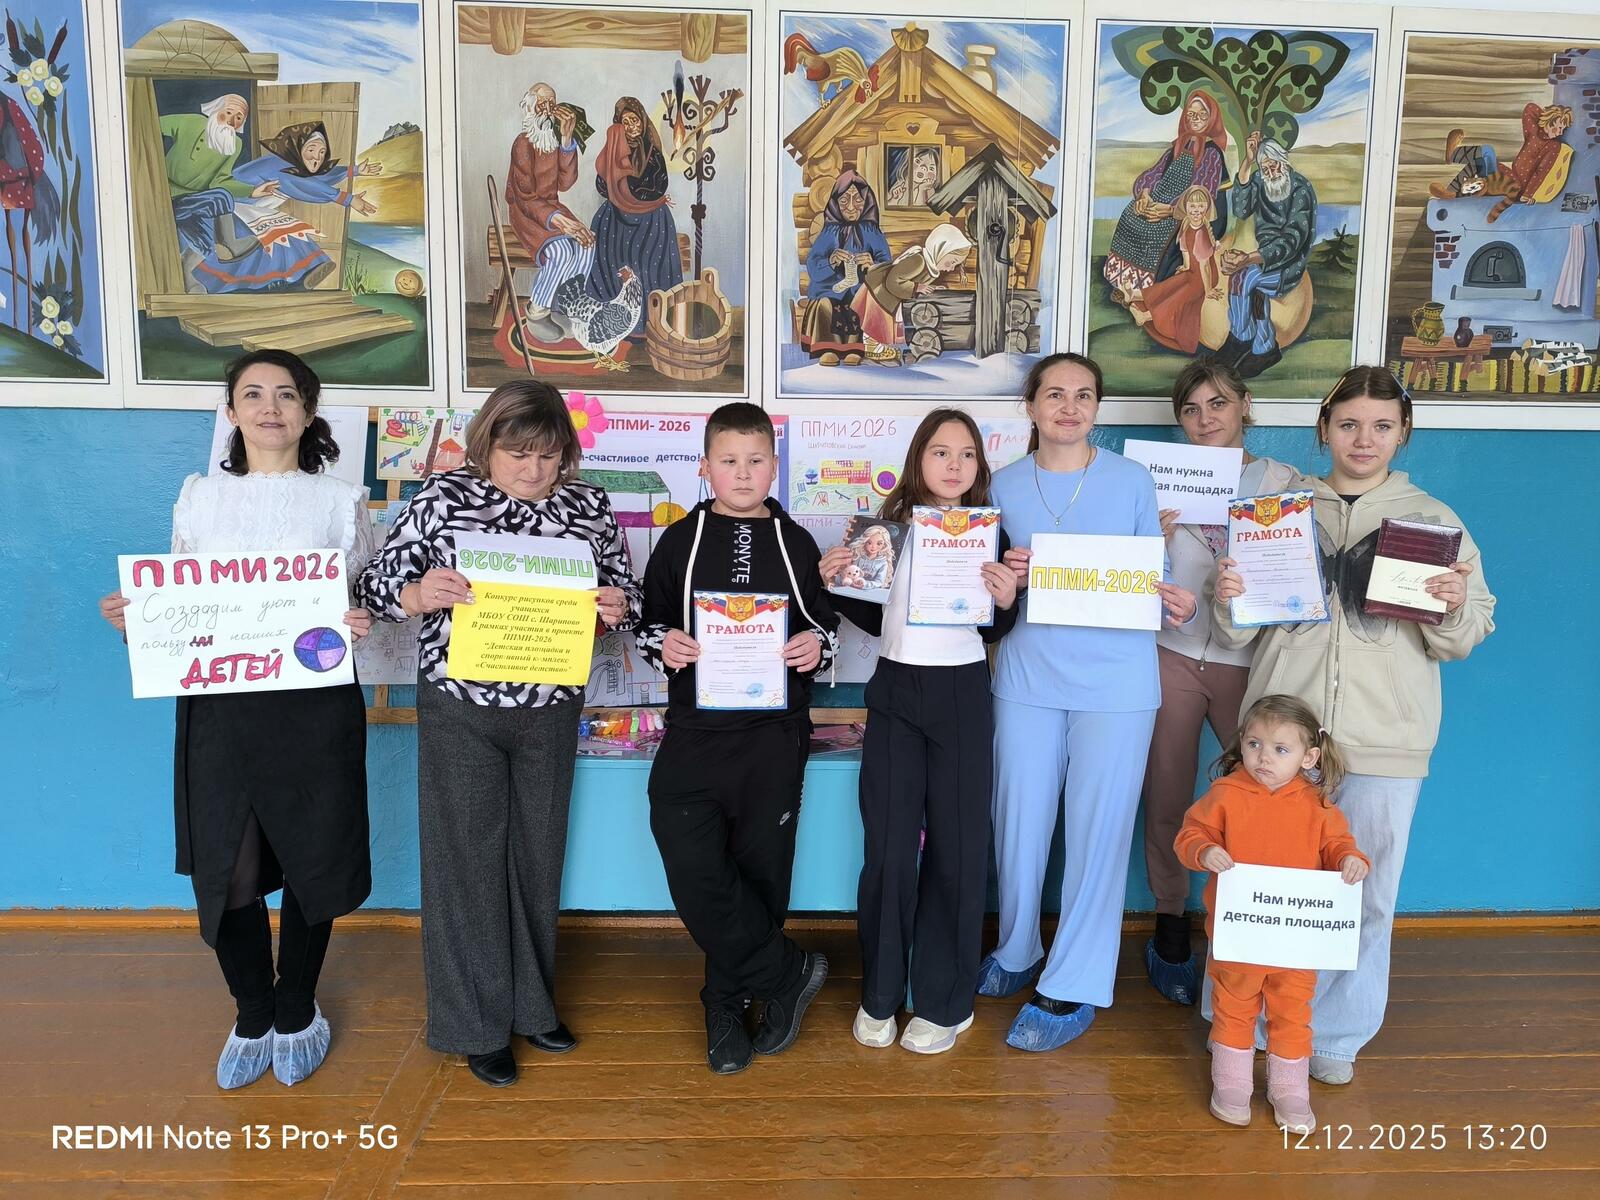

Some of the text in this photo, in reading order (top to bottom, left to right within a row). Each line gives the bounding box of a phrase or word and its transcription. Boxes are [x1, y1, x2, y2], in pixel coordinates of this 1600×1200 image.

[658, 420, 690, 432] 2026
[802, 420, 847, 438] ППМИ
[850, 418, 897, 438] 2026
[656, 453, 701, 462] детство!
[1149, 463, 1214, 479] Нам нужна
[1172, 484, 1234, 496] площадка
[922, 538, 986, 548] ГРАМОТА
[1236, 528, 1303, 542] ГРАМОТА
[133, 552, 339, 588] ППМИ 2026
[460, 549, 594, 578] ППМИ-2026
[1031, 566, 1160, 594] ППМИ-2026
[484, 592, 578, 609] Конкурс рисунков среди
[142, 592, 320, 634] Создадим уют и
[510, 606, 550, 614] учащихся
[478, 612, 506, 620] МБОУ
[506, 614, 530, 622] СОШ
[539, 616, 580, 626] Шарипово
[478, 623, 508, 632] рамках
[510, 625, 544, 633] участия
[552, 628, 584, 636] проекте
[706, 624, 776, 634] ГРАМОТА
[141, 638, 186, 656] пользу
[230, 628, 288, 640] наших
[502, 634, 553, 642] ППМИ-2026
[180, 648, 284, 689] ДЕТЕЙ
[1252, 892, 1334, 909] Нам нужна
[1224, 910, 1356, 931] детская площадка
